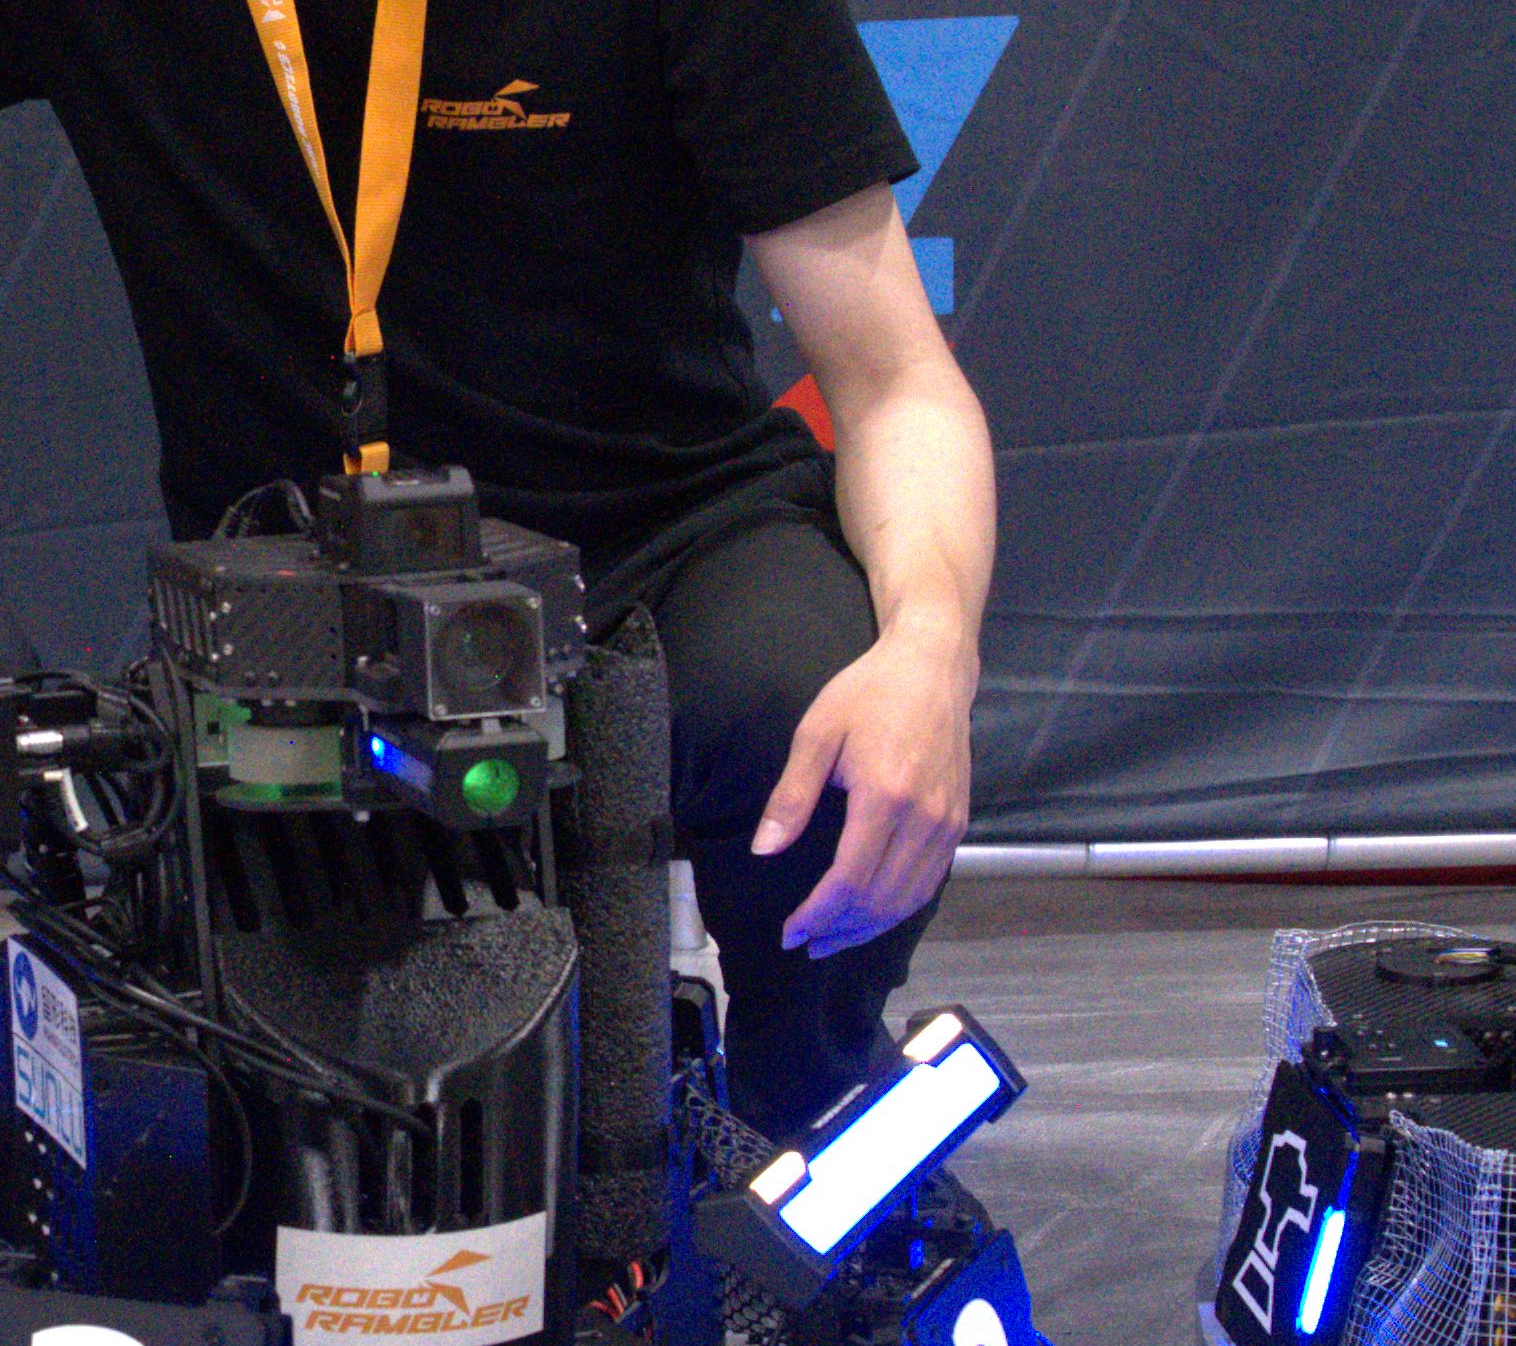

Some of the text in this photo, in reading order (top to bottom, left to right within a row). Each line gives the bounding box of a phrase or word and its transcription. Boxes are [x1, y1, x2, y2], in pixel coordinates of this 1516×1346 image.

[420, 98, 504, 116] ROBO
[427, 112, 571, 131] RAMBLER
[296, 1283, 441, 1308] ROBO
[304, 1295, 530, 1335] RAMBLER
